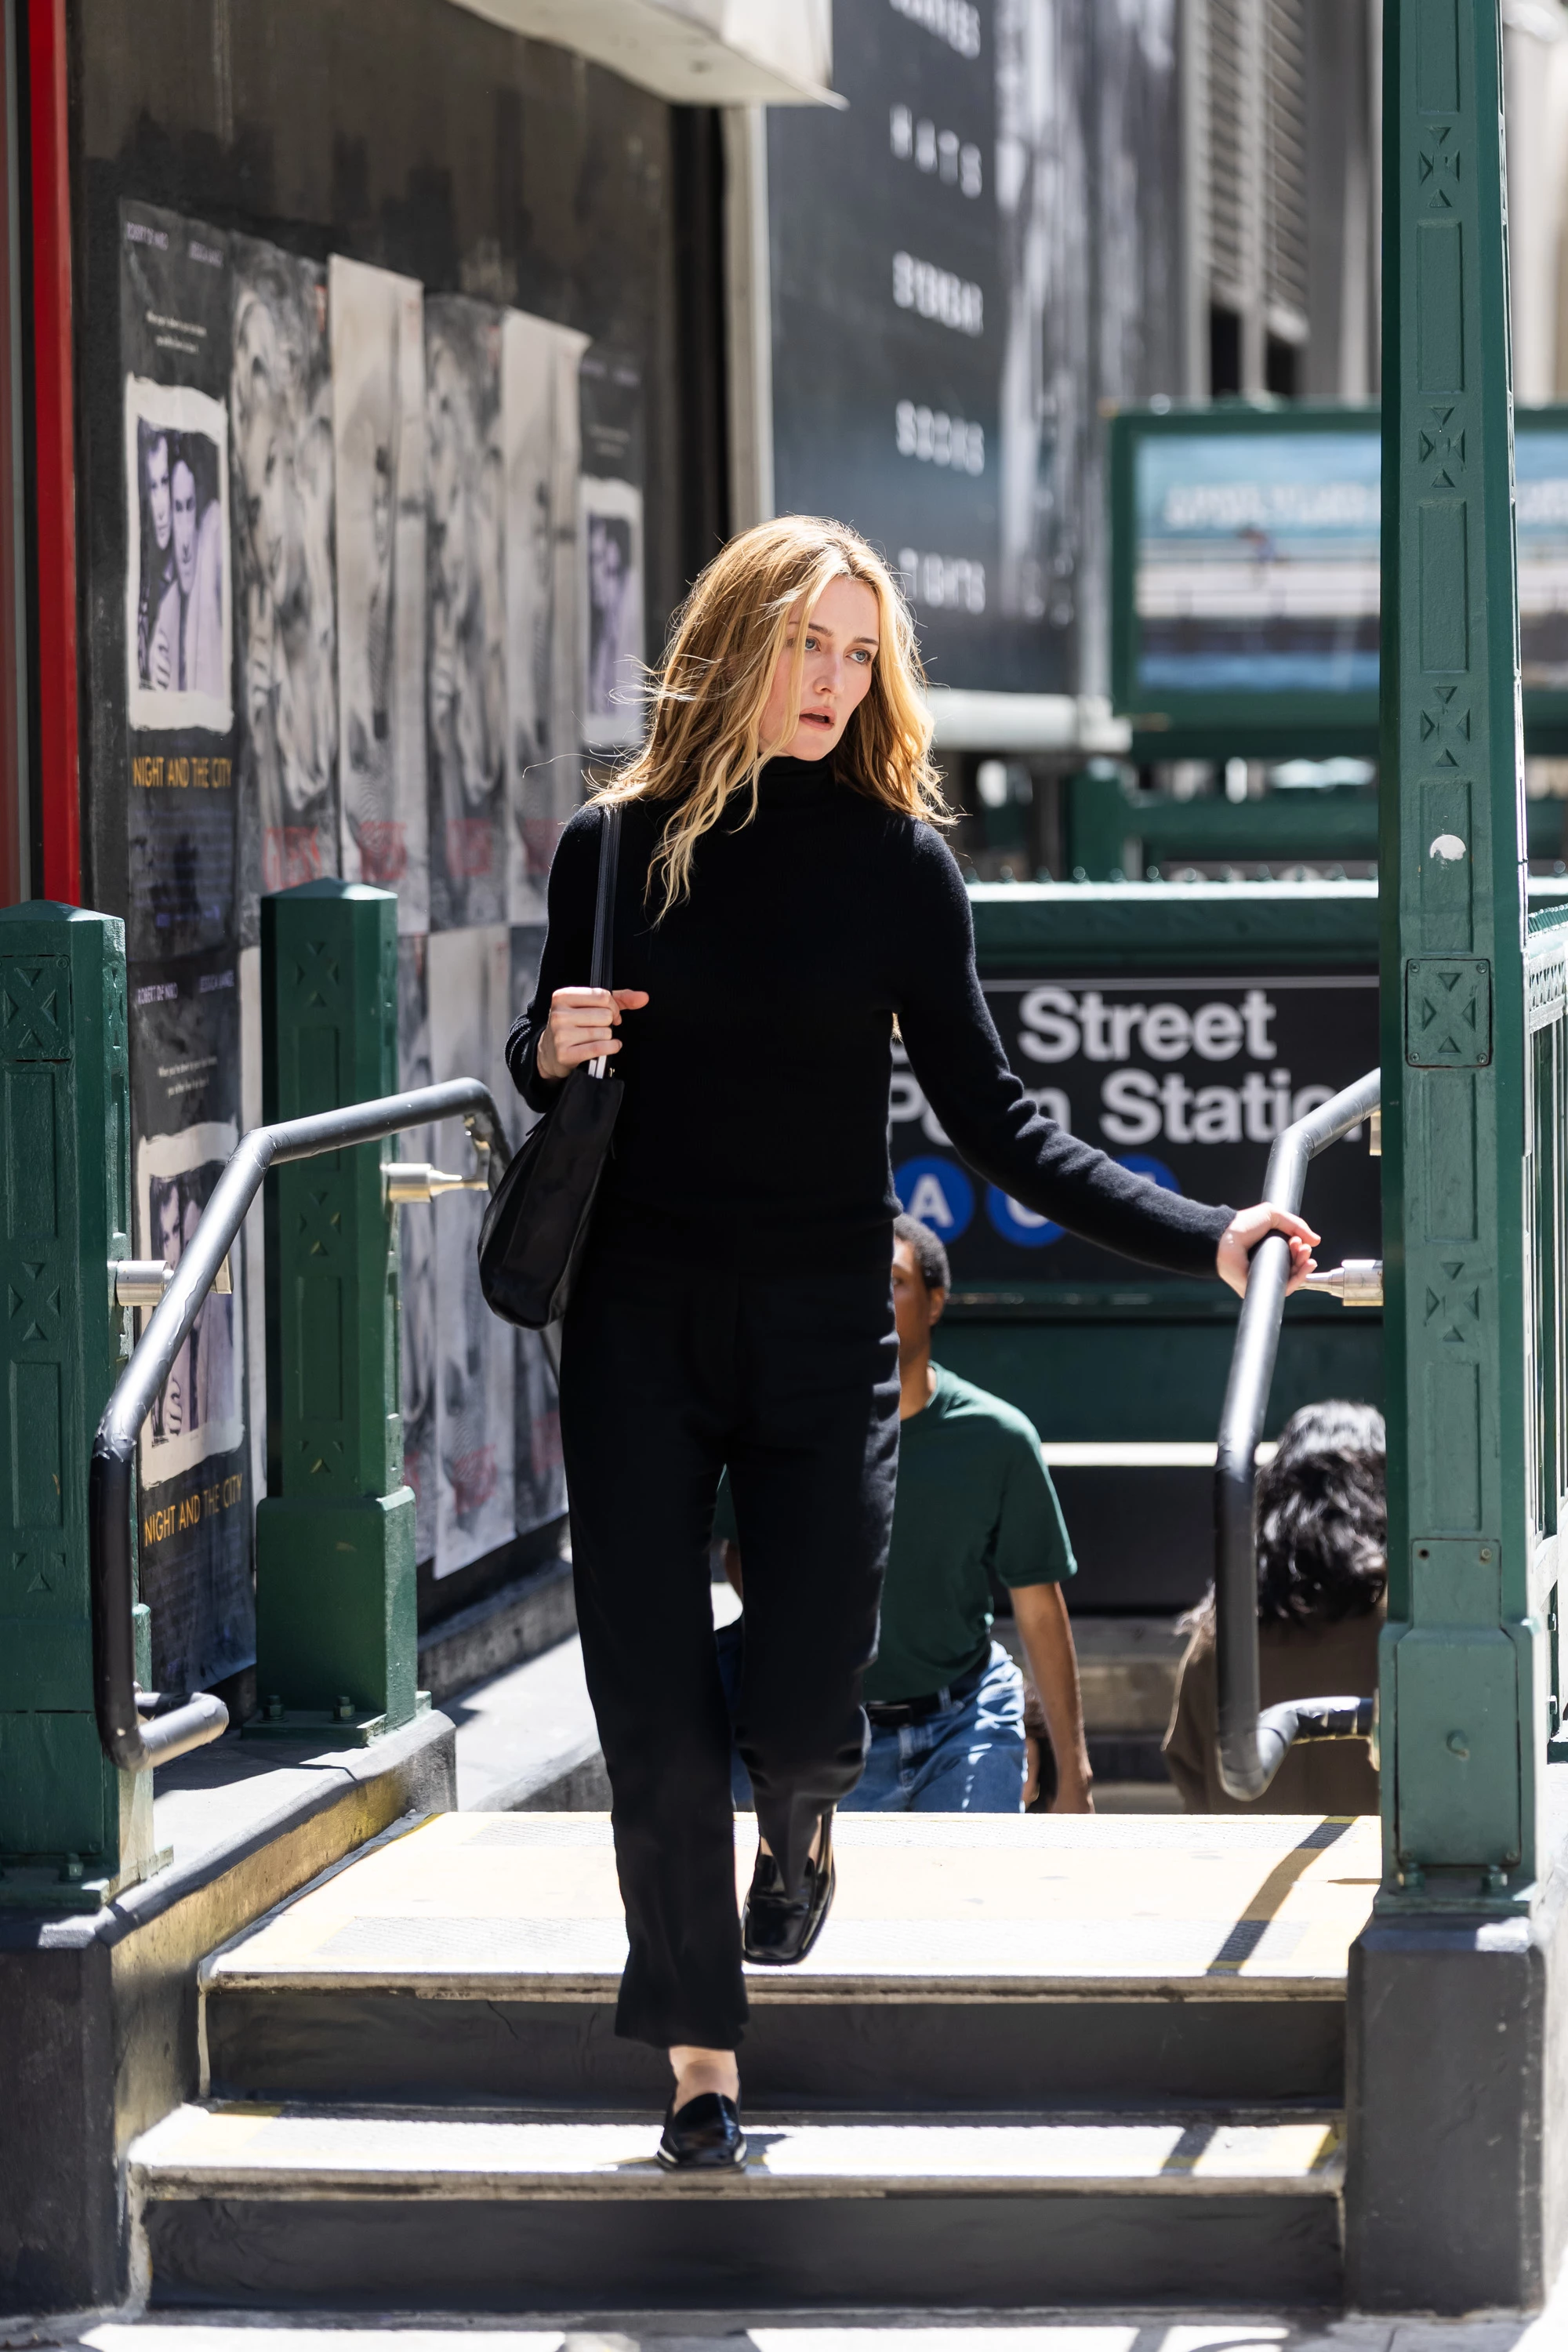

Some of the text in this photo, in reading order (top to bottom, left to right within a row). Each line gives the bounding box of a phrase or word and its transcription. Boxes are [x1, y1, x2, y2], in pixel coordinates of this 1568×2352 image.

[889, 101, 982, 199] HATS
[895, 399, 985, 477] SOCKS
[132, 756, 232, 788] NIGHT AND THE CITY
[1018, 985, 1276, 1063] Street
[887, 1067, 1363, 1146] Pn Stati
[907, 1174, 953, 1228] A
[144, 1473, 243, 1548] NIGHT AND THE CITY
